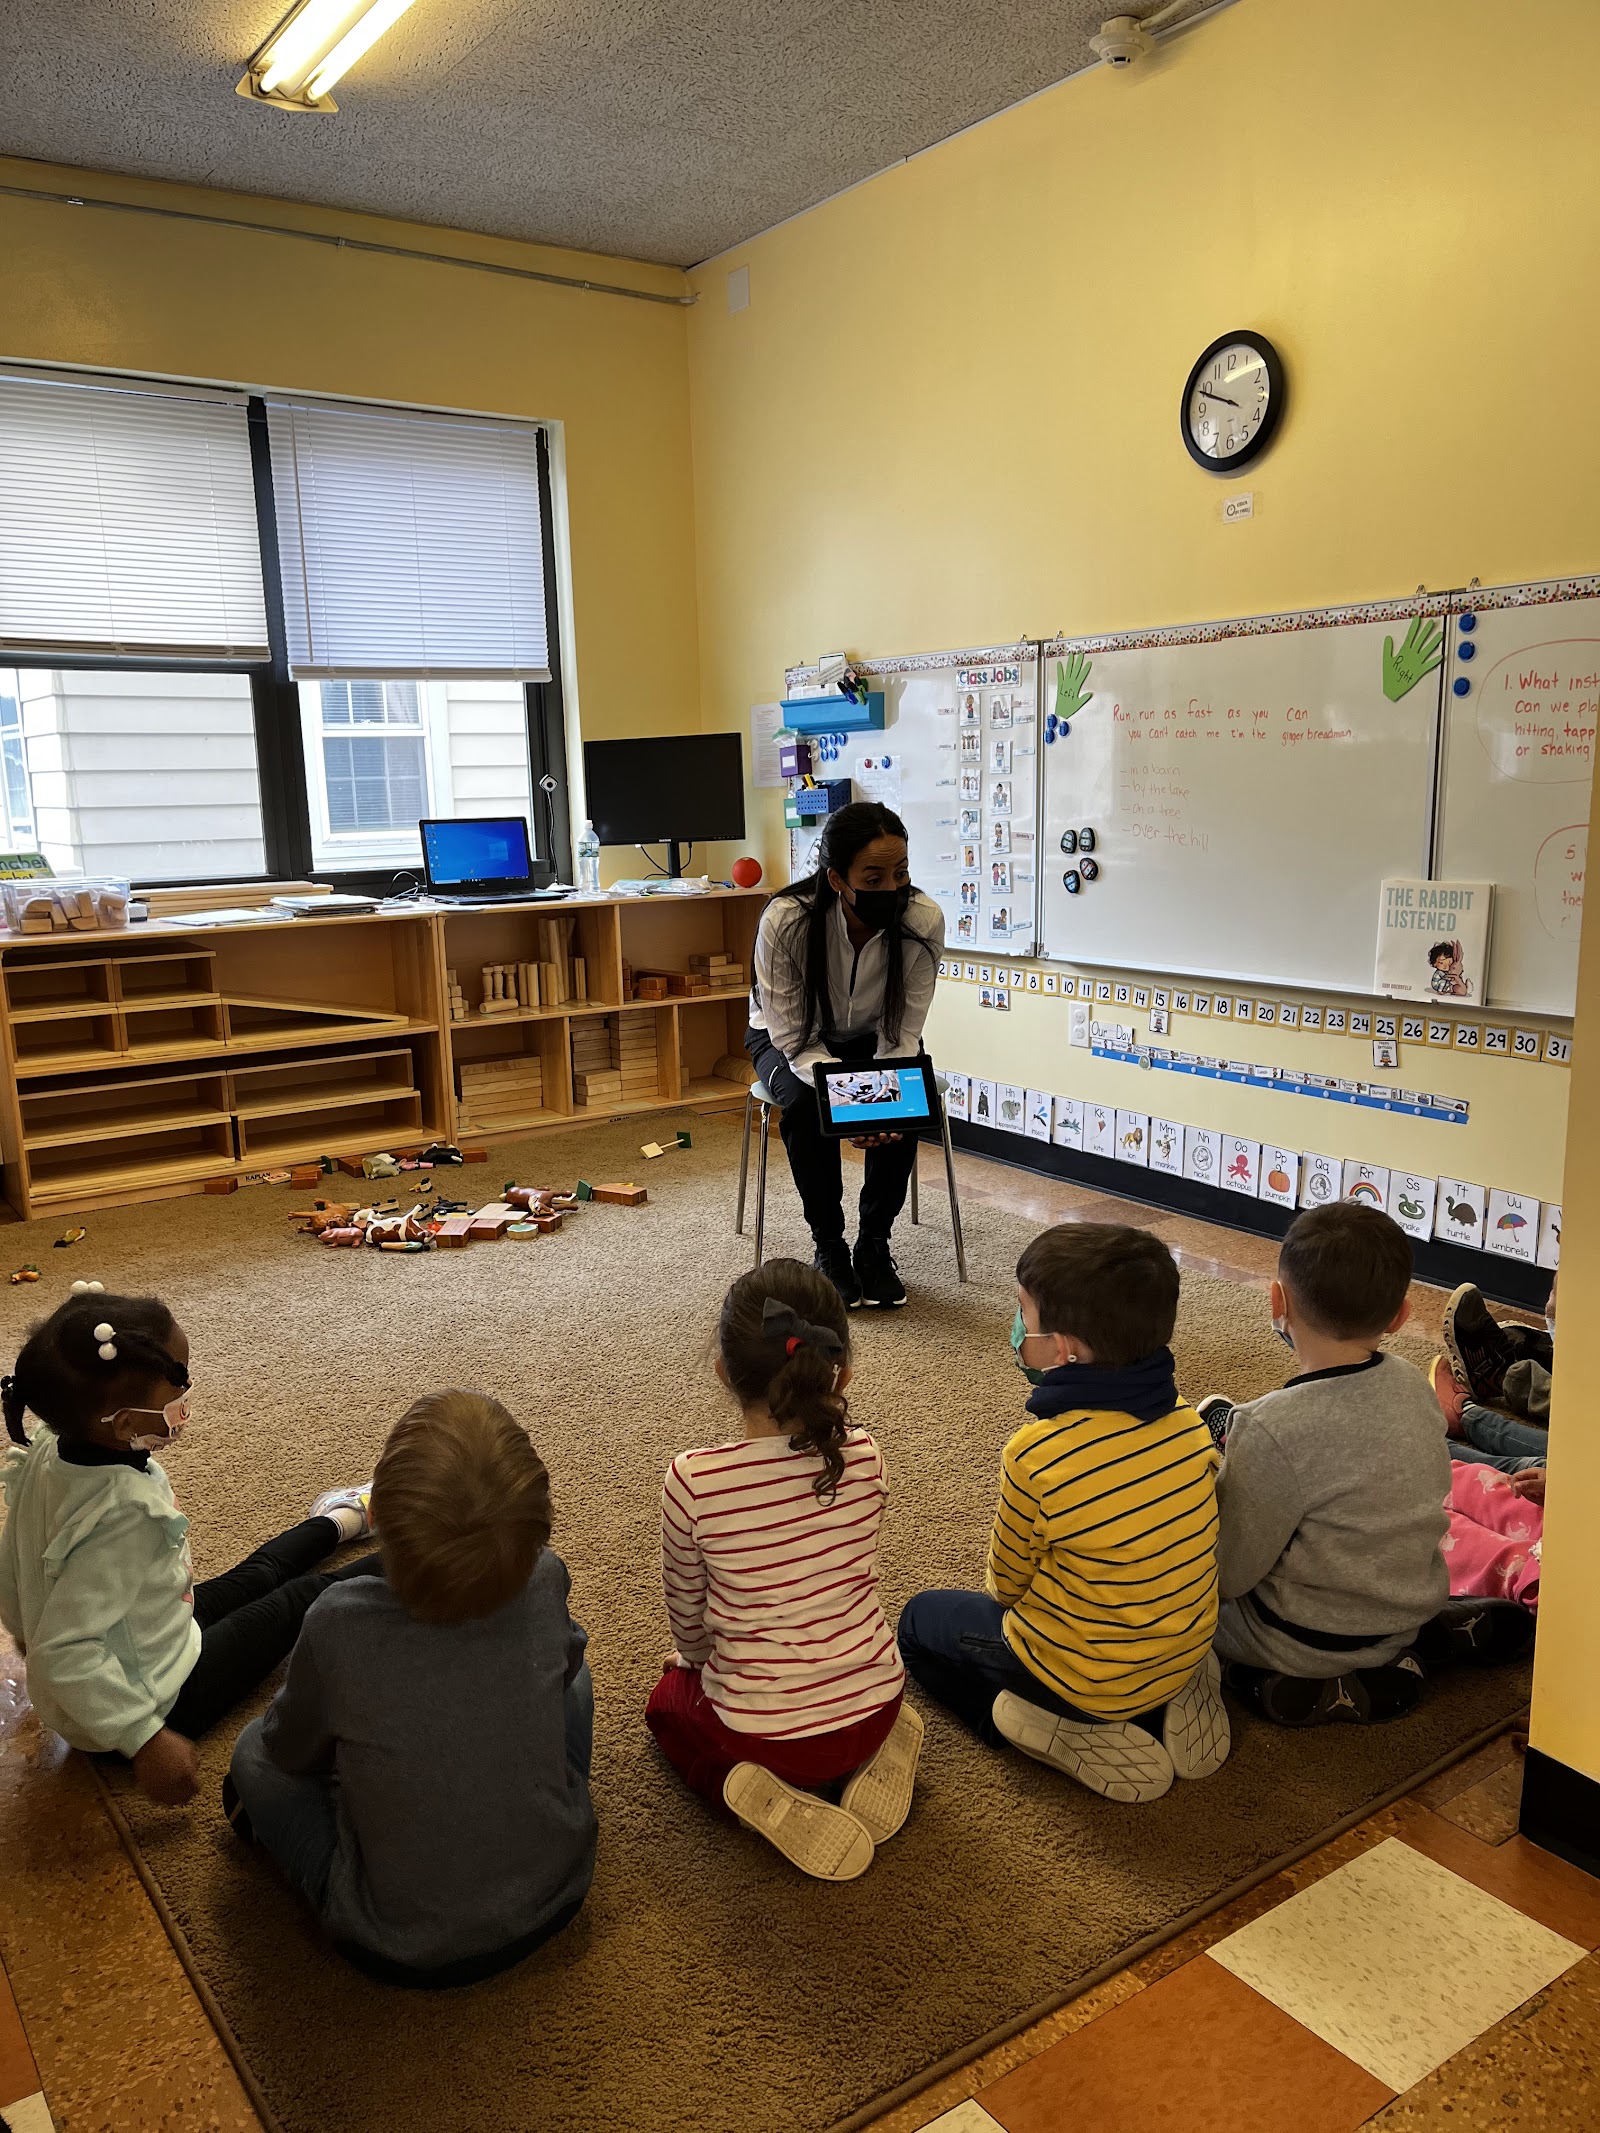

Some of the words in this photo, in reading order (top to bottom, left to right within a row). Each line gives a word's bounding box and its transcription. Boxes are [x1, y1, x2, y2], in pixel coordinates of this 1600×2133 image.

[1227, 354, 1237, 371] 12
[1213, 363, 1221, 380] 11
[1253, 367, 1262, 384] 2
[1202, 380, 1213, 398] 10
[1257, 386, 1265, 403] 3
[1198, 402, 1207, 419] 9
[1252, 407, 1261, 423] 4
[1202, 420, 1210, 436] 8
[1241, 425, 1249, 441] 5
[1212, 432, 1220, 448] 7
[1226, 433, 1235, 450] 6
[960, 670, 988, 685] Class
[990, 666, 1018, 683] Jobs
[1392, 655, 1414, 683] Right
[1504, 674, 1513, 690] 1.
[1519, 669, 1559, 690] What
[1060, 683, 1075, 701] Left
[1113, 703, 1135, 723] Run,
[1138, 708, 1155, 721] run
[1163, 708, 1177, 720] as
[1186, 699, 1213, 719] fast
[1227, 708, 1241, 719] as
[1252, 708, 1269, 725] you
[1550, 701, 1570, 713] we
[1128, 729, 1142, 744] you
[1175, 729, 1198, 739] catch
[1251, 728, 1266, 739] the
[1563, 721, 1596, 742] tapp
[1515, 745, 1531, 757] or
[1541, 742, 1590, 763] shaking
[1149, 783, 1167, 796] the
[1386, 887, 1414, 907] THE
[1418, 889, 1474, 911] RABBIT
[1386, 909, 1457, 932] LISTENED
[938, 963, 946, 975] 2
[952, 964, 959, 977] 3
[968, 965, 974, 979] 4
[982, 969, 989, 982] 5
[998, 970, 1005, 983] 6
[1014, 973, 1021, 986] 7
[1029, 976, 1037, 989] 8
[1047, 978, 1054, 990] 9
[1063, 981, 1074, 994] 10
[1082, 983, 1091, 997] 11
[1098, 985, 1110, 999] 12
[1117, 987, 1127, 1001] 13
[1134, 991, 1145, 1006] 14
[1155, 992, 1165, 1007] 15
[1176, 995, 1187, 1009] 16
[1196, 998, 1208, 1012] 17
[1217, 1000, 1228, 1014] 18
[1238, 1003, 1248, 1017] 19
[1258, 1007, 1275, 1022] 20
[1282, 1009, 1296, 1023] 21
[1304, 1011, 1320, 1025] 22
[1328, 1013, 1345, 1027] 23
[1352, 1017, 1369, 1032] 24
[1376, 1019, 1395, 1036] 25
[1403, 1023, 1423, 1038] 26
[1430, 1026, 1450, 1042] 27
[1457, 1029, 1478, 1046] 28
[1486, 1032, 1506, 1049] 29
[1514, 1035, 1536, 1053] 30
[1548, 1041, 1567, 1059] 31
[1091, 1021, 1108, 1037] Our
[1116, 1024, 1132, 1043] Day
[953, 1075, 961, 1085] Ff
[979, 1082, 989, 1094] Gg
[1005, 1087, 1015, 1098] Hh
[1093, 1107, 1105, 1118] Kk
[1159, 1121, 1176, 1136] Mm
[1062, 1136, 1072, 1145] jet
[1197, 1131, 1210, 1144] Nn
[1092, 1143, 1105, 1153] kite
[1234, 1140, 1248, 1153] Oo
[1126, 1152, 1137, 1160] lion
[1275, 1150, 1288, 1165] Pp
[1154, 1159, 1178, 1173] monkey
[1315, 1158, 1330, 1174] Qq
[1358, 1166, 1375, 1179] Rr
[245, 1172, 271, 1181] KAPLAN
[1406, 1177, 1420, 1191] Ss
[1225, 1179, 1252, 1192] octopus
[1454, 1183, 1469, 1198] Tt
[1264, 1190, 1292, 1203] pumpkin
[1506, 1195, 1522, 1210] Uu
[1399, 1221, 1421, 1233] snake
[1445, 1227, 1471, 1241] turtle
[1491, 1241, 1529, 1258] umbrella
